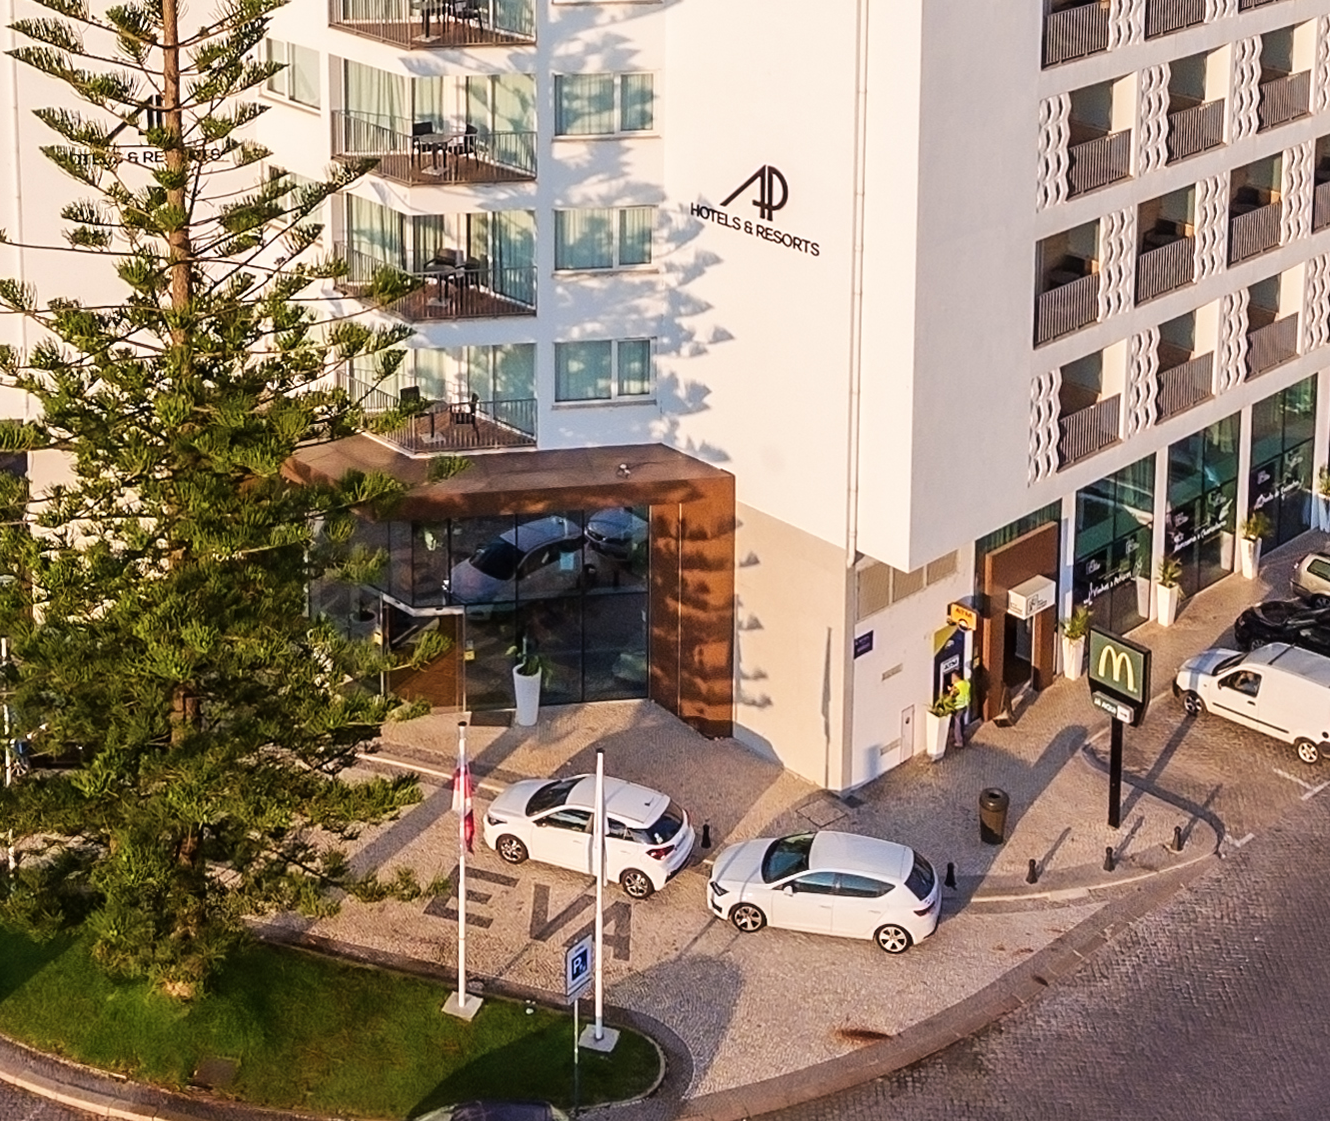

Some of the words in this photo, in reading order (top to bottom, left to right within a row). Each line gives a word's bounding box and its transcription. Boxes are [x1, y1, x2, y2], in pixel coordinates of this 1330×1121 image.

[690, 202, 742, 231] HOTELS
[743, 220, 754, 236] &
[755, 224, 820, 257] RESORTS
[423, 864, 632, 962] EVA
[573, 956, 582, 975] P
